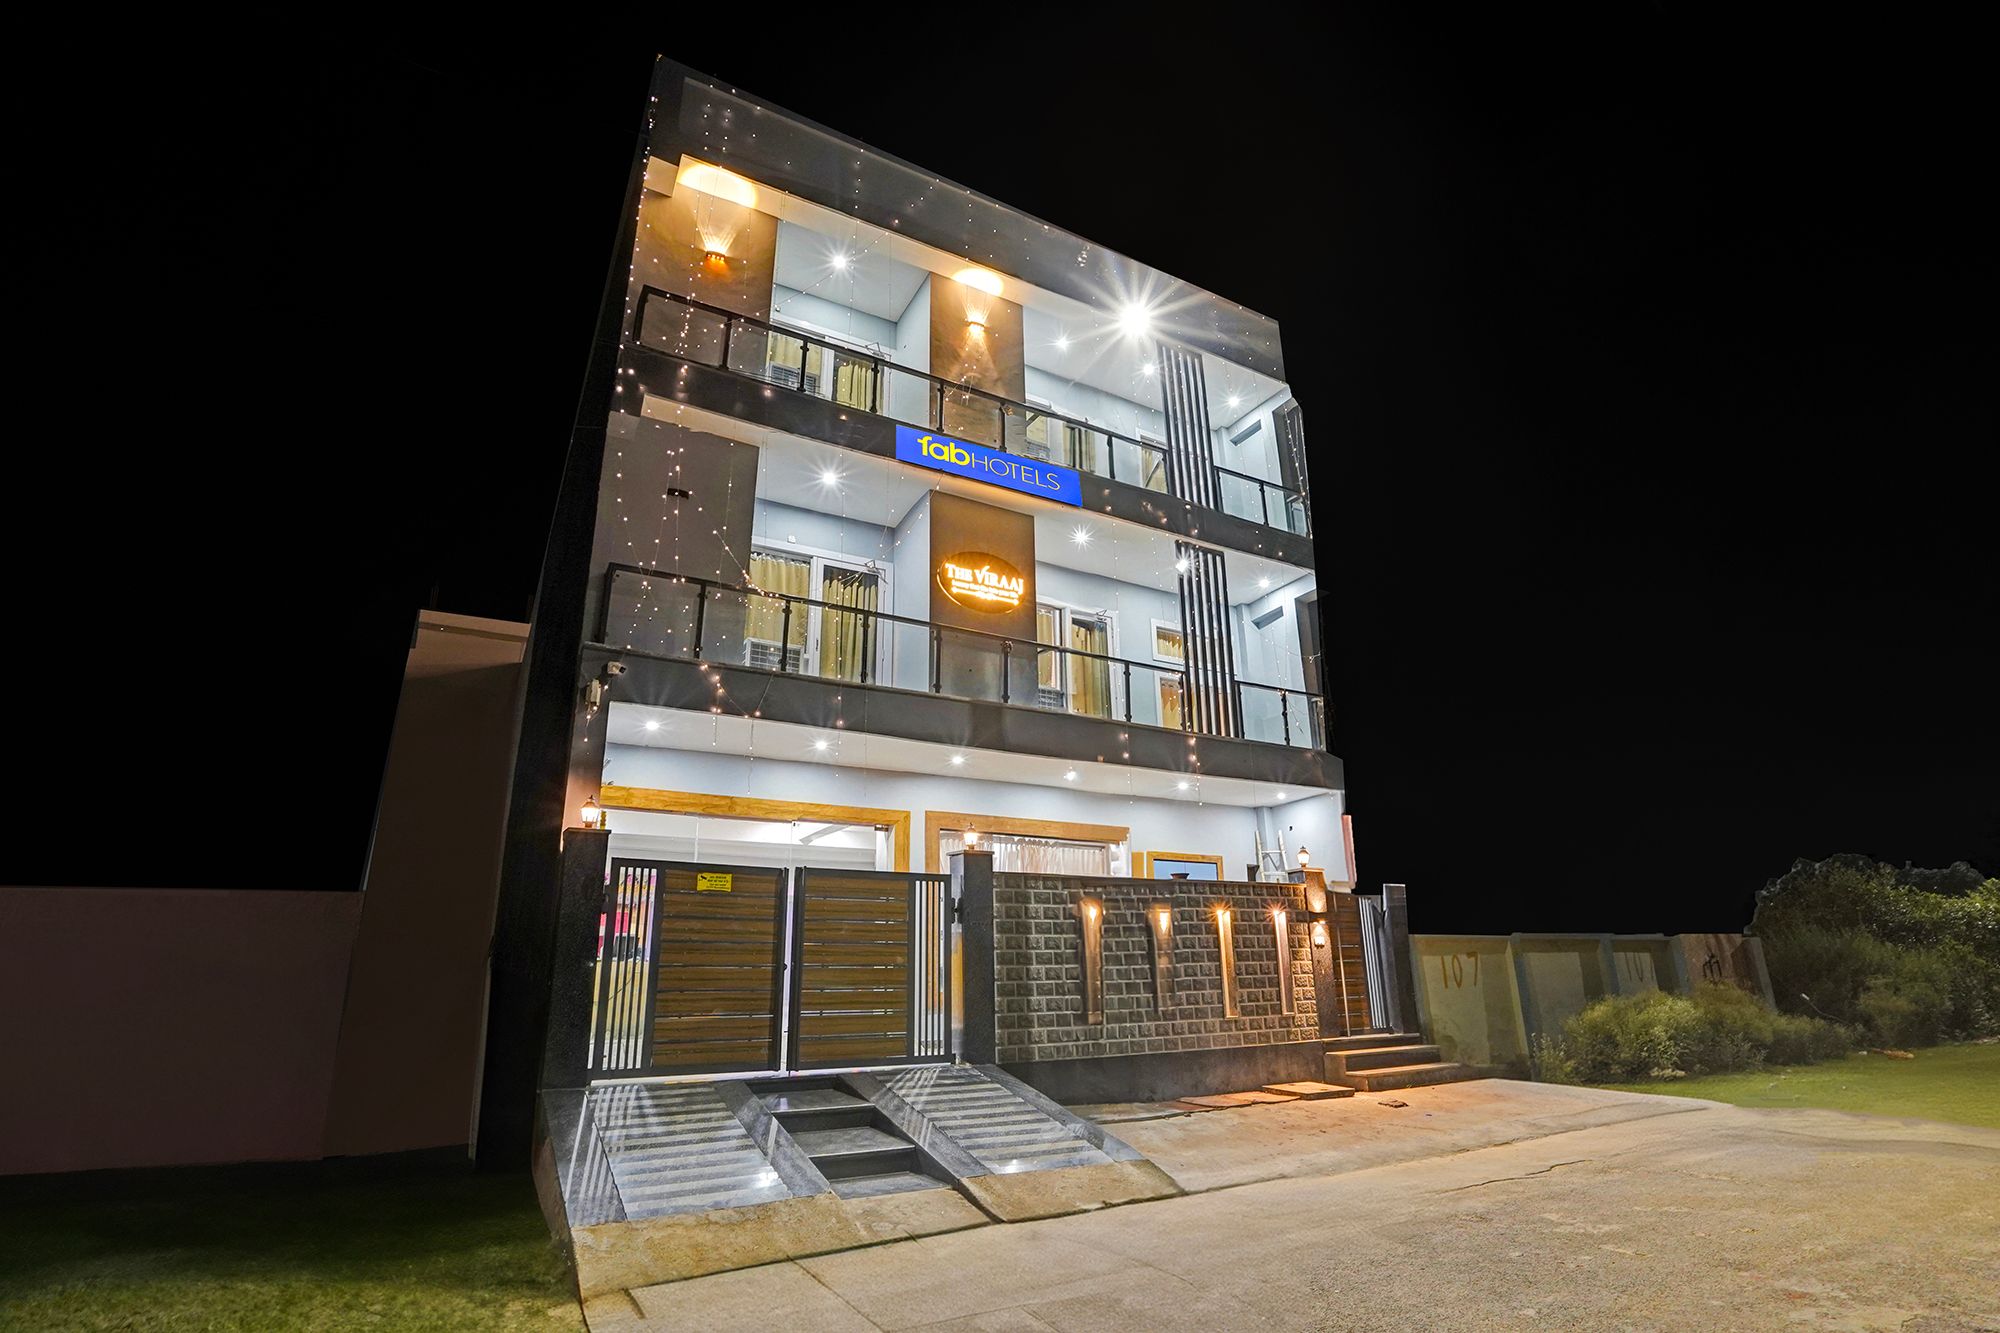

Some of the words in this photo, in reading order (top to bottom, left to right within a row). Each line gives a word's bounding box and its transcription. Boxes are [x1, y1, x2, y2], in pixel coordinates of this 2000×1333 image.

[917, 436, 1061, 491] fabHOTELS
[945, 563, 973, 581] THE
[974, 565, 1024, 595] VIRAAJ
[1441, 951, 1478, 989] 107
